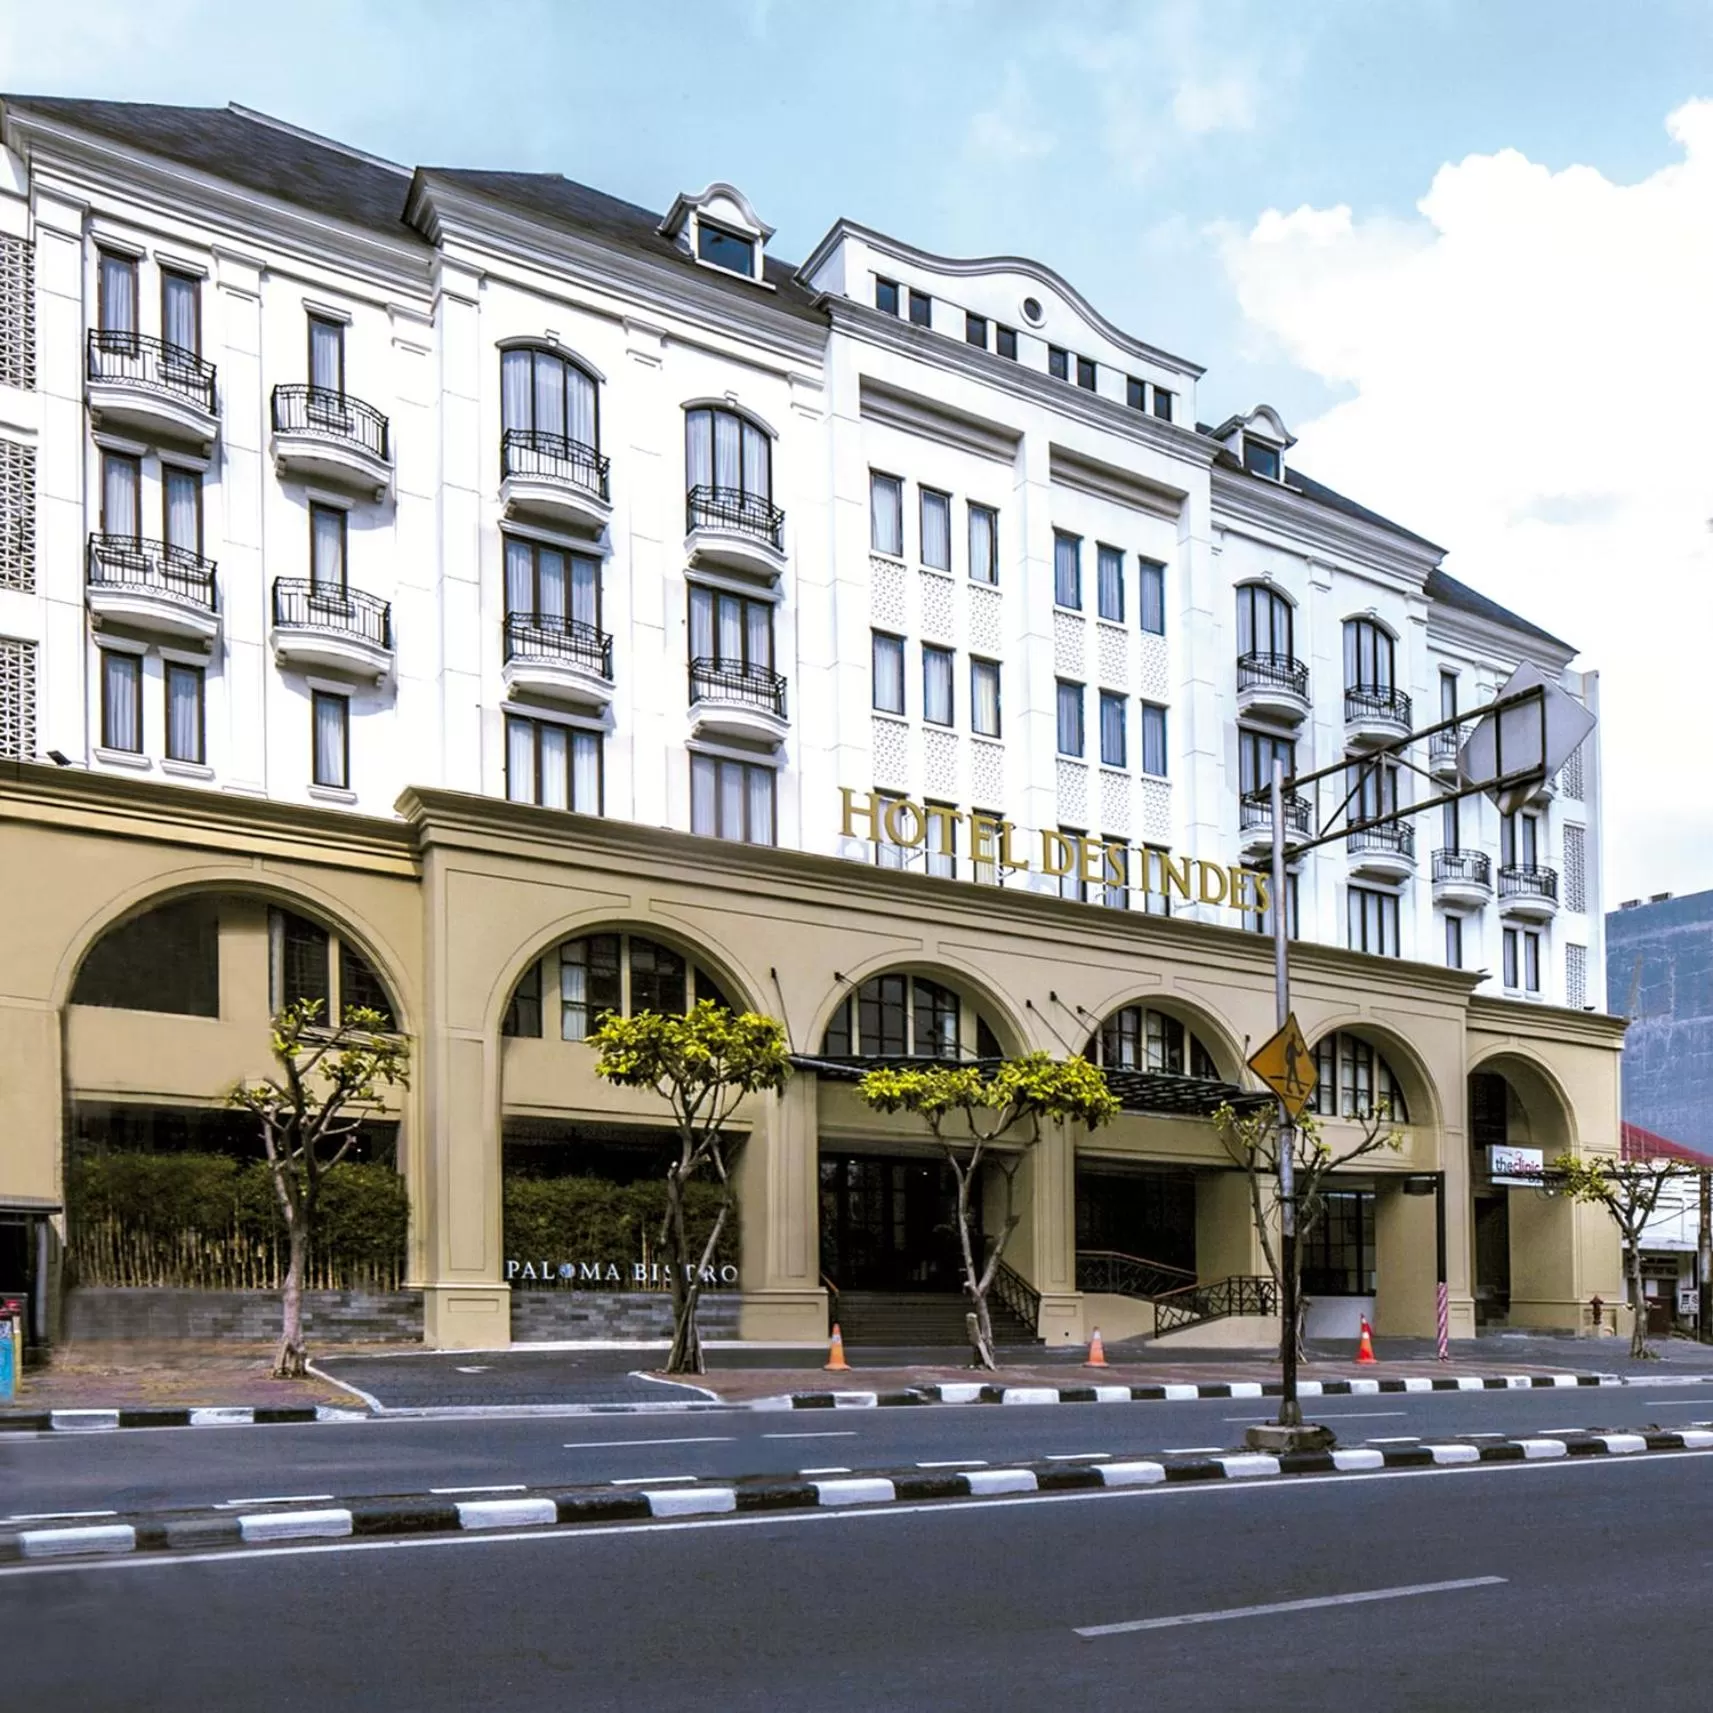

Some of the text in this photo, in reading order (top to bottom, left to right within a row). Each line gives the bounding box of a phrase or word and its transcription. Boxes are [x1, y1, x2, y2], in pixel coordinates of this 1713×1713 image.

[838, 786, 1271, 914] HOTEL DES INDES
[506, 1260, 621, 1281] PALOMA
